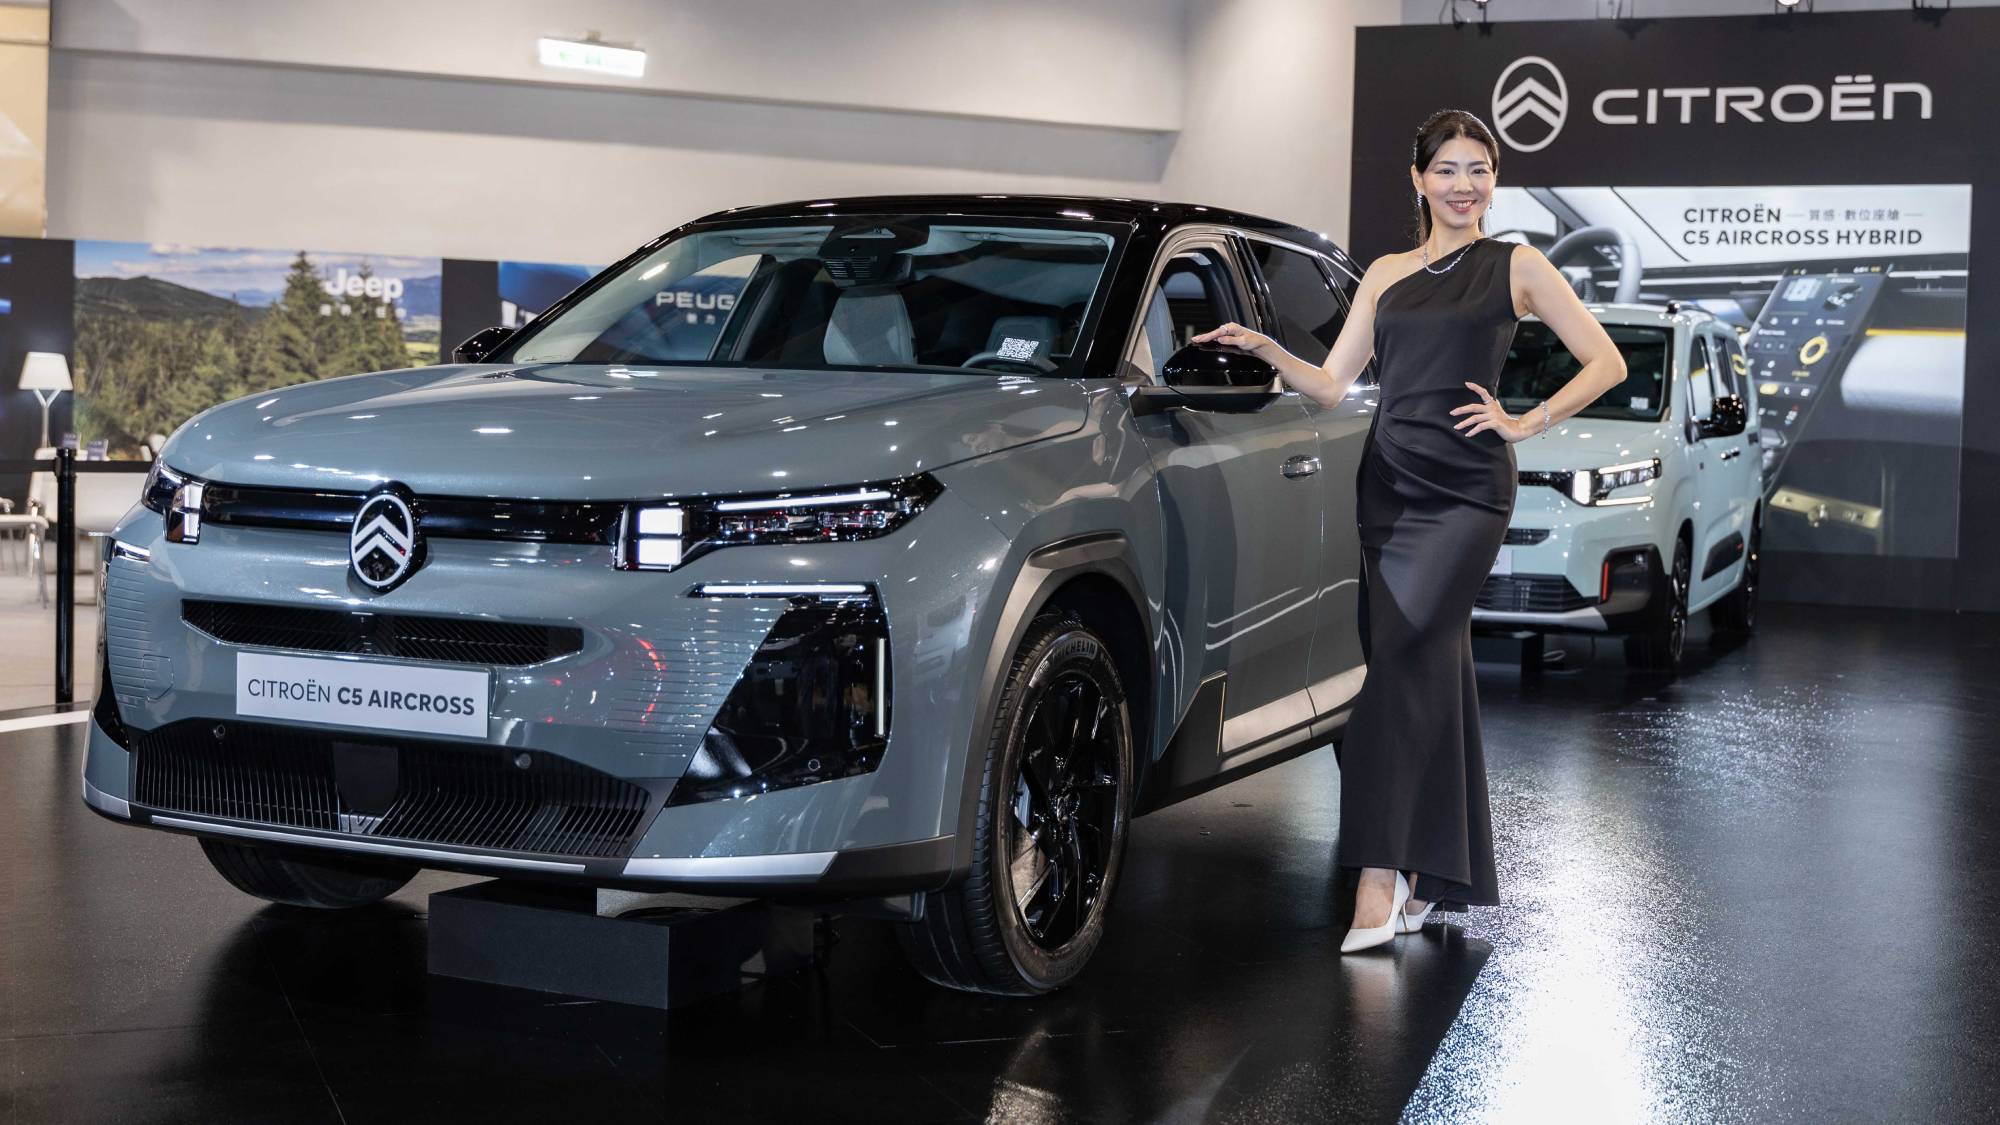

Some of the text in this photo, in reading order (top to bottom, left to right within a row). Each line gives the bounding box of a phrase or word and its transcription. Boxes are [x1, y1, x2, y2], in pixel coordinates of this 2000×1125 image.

[1592, 74, 1933, 125] CITROËN
[1683, 203, 1782, 223] CITROËN
[1683, 229, 1923, 245] C5 AIRCROSS HYBRID
[324, 268, 404, 304] Jeep
[656, 291, 736, 310] PEUG
[247, 678, 476, 716] CITROËN C5 AIRCROSS
